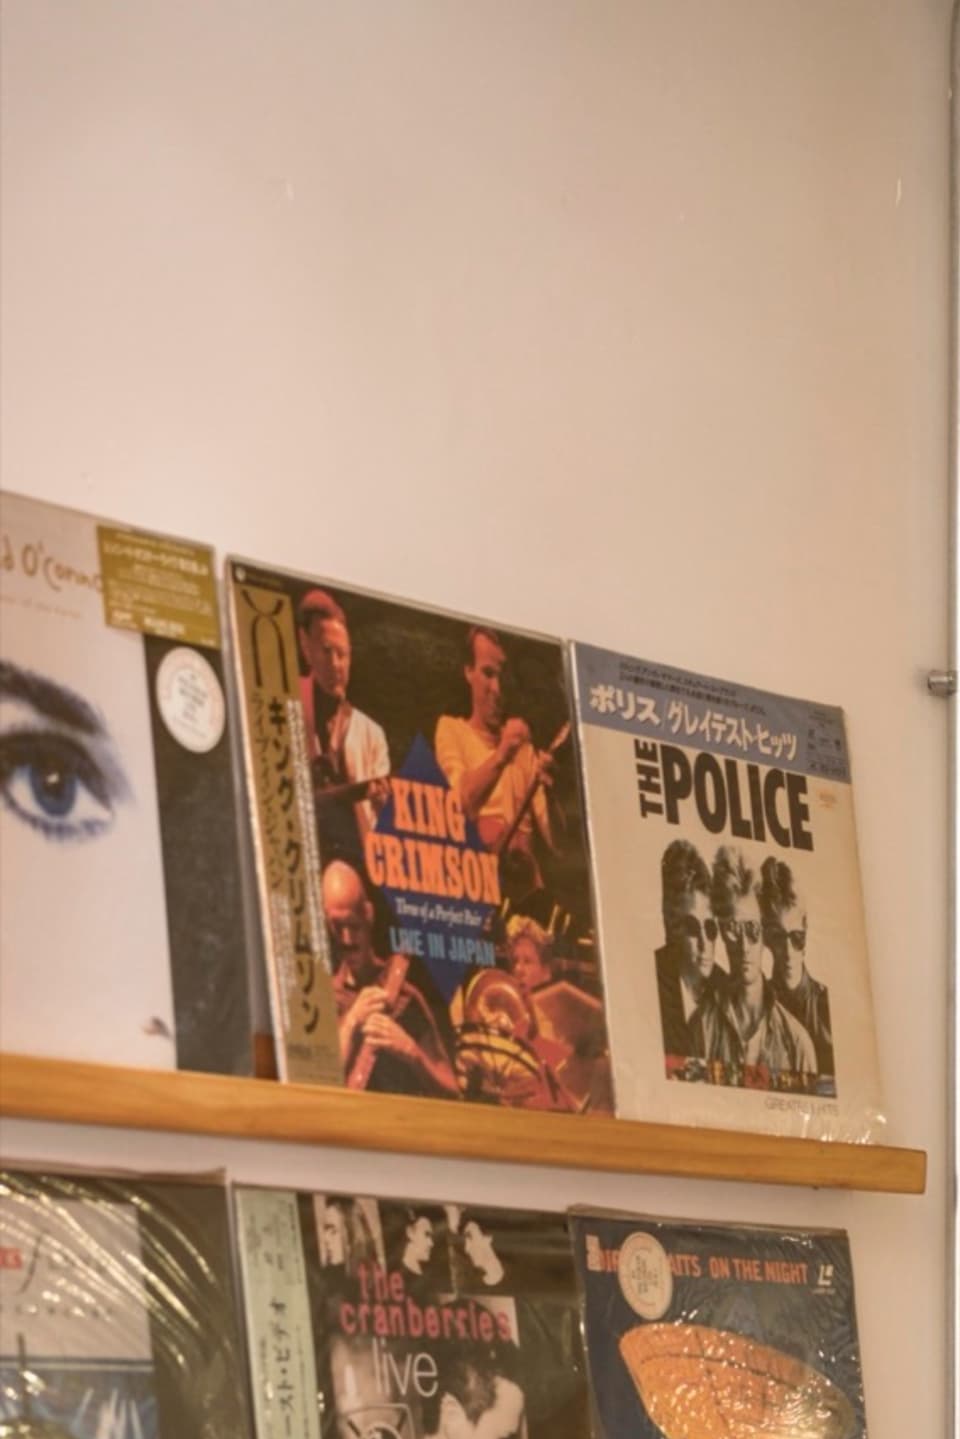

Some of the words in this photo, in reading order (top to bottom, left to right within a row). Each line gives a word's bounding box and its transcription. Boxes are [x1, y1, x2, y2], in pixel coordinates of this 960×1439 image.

[390, 777, 466, 842] KING
[634, 738, 664, 818] THE
[660, 743, 814, 851] POLICE
[365, 832, 501, 904] CRIMSON
[389, 926, 424, 957] LIVE
[426, 932, 446, 960] IN
[448, 935, 496, 967] JAPAN
[358, 1263, 404, 1302] the
[708, 1256, 730, 1279] ON
[732, 1258, 762, 1281] THE
[764, 1262, 809, 1285] NIGHT
[339, 1298, 513, 1342] cranberries
[372, 1337, 439, 1397] live
